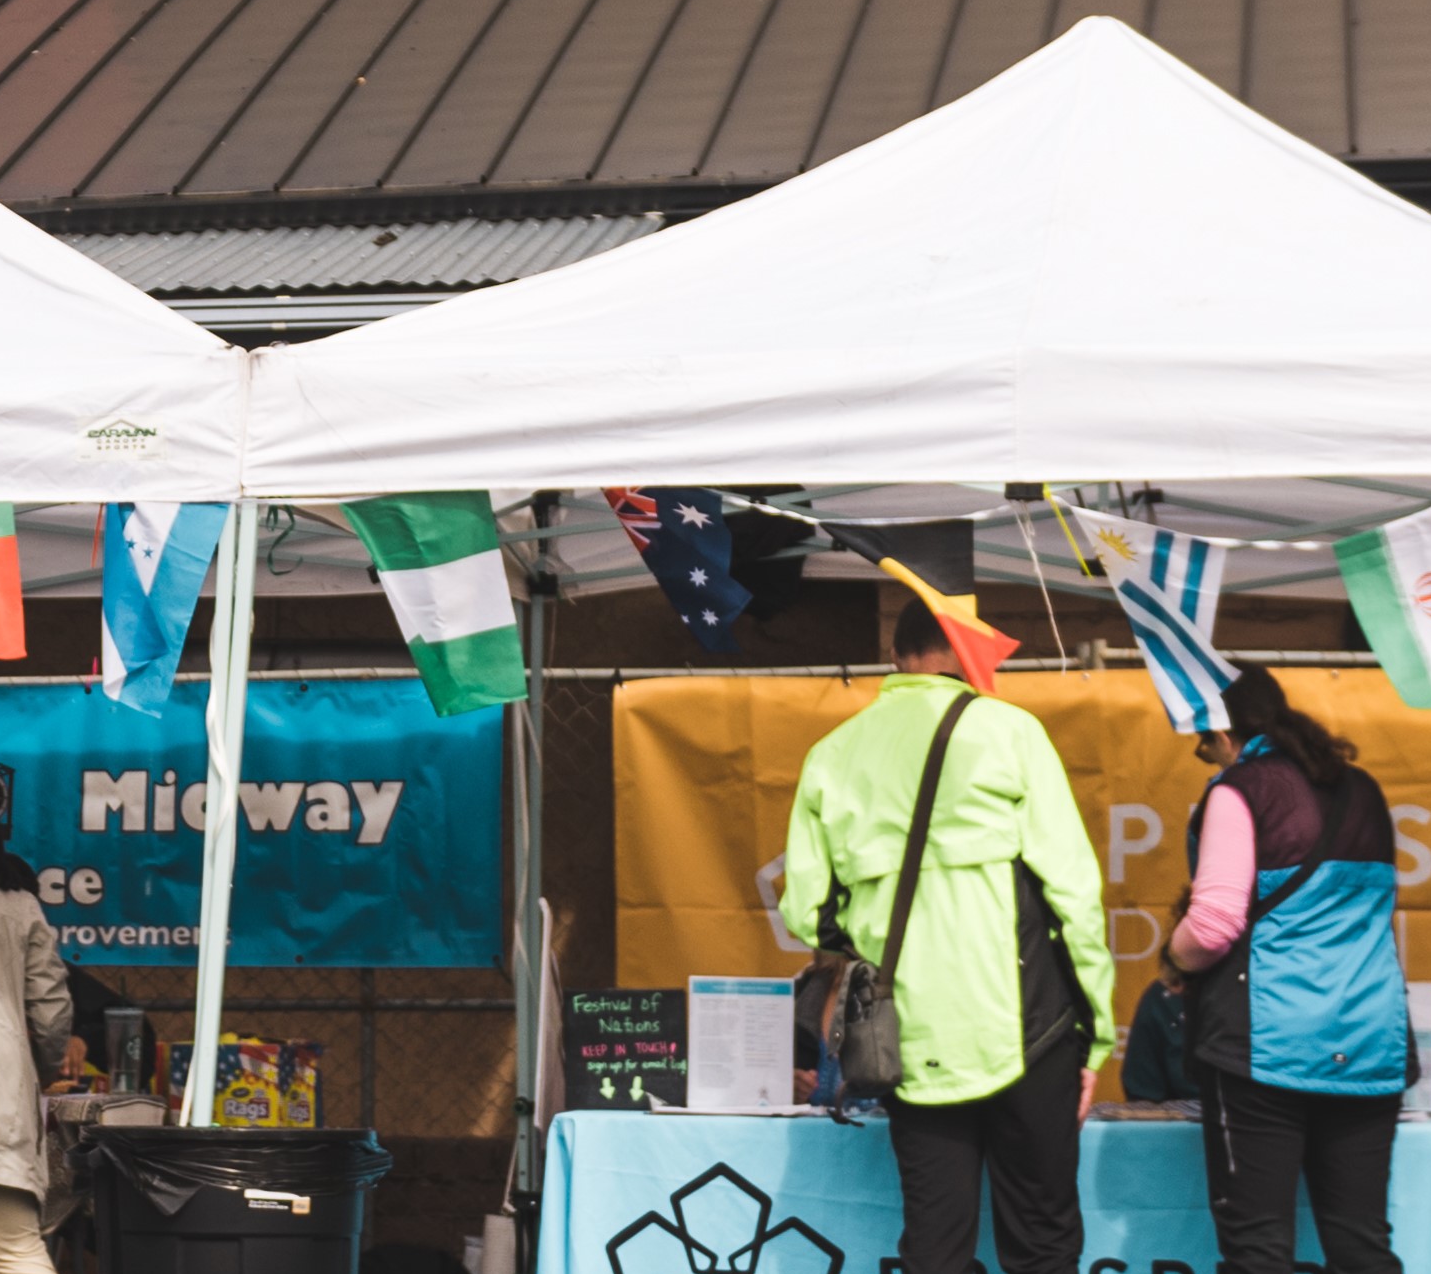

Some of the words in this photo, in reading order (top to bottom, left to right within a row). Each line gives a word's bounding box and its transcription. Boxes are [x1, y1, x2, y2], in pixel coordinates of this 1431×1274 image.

[573, 993, 631, 1013] Festival
[641, 992, 662, 1012] of
[599, 1016, 660, 1033] Nations
[582, 1044, 607, 1057] KEEP
[615, 1044, 626, 1055] IN
[224, 1099, 267, 1121] Rags
